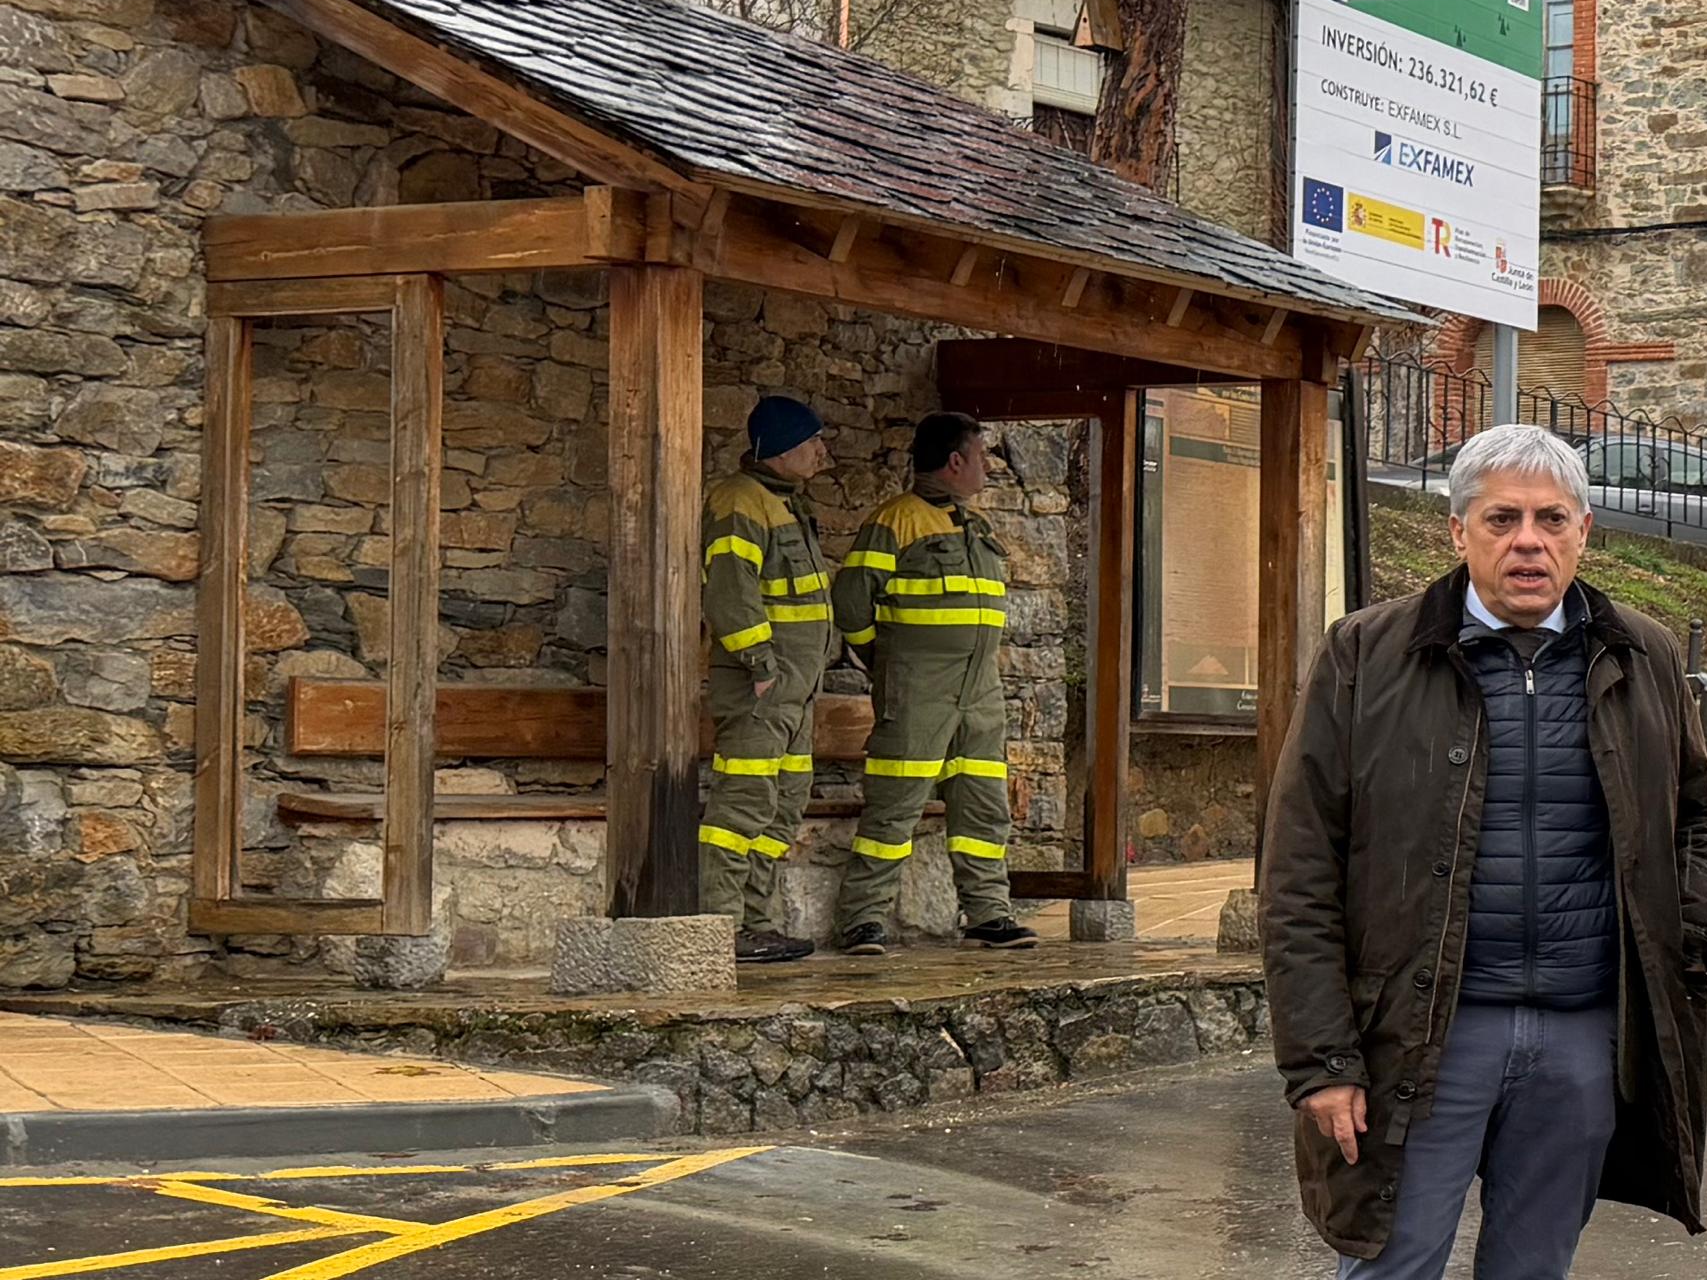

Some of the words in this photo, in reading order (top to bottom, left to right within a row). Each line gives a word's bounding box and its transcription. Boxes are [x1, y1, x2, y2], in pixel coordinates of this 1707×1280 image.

[1322, 24, 1402, 73] INVERSIÓN:
[1409, 57, 1486, 104] 236.321,62
[1490, 87, 1499, 108] €
[1321, 78, 1384, 113] CONSTRUYE:
[1388, 100, 1440, 133] EXFAMEX
[1399, 142, 1475, 188] EXFAMEX
